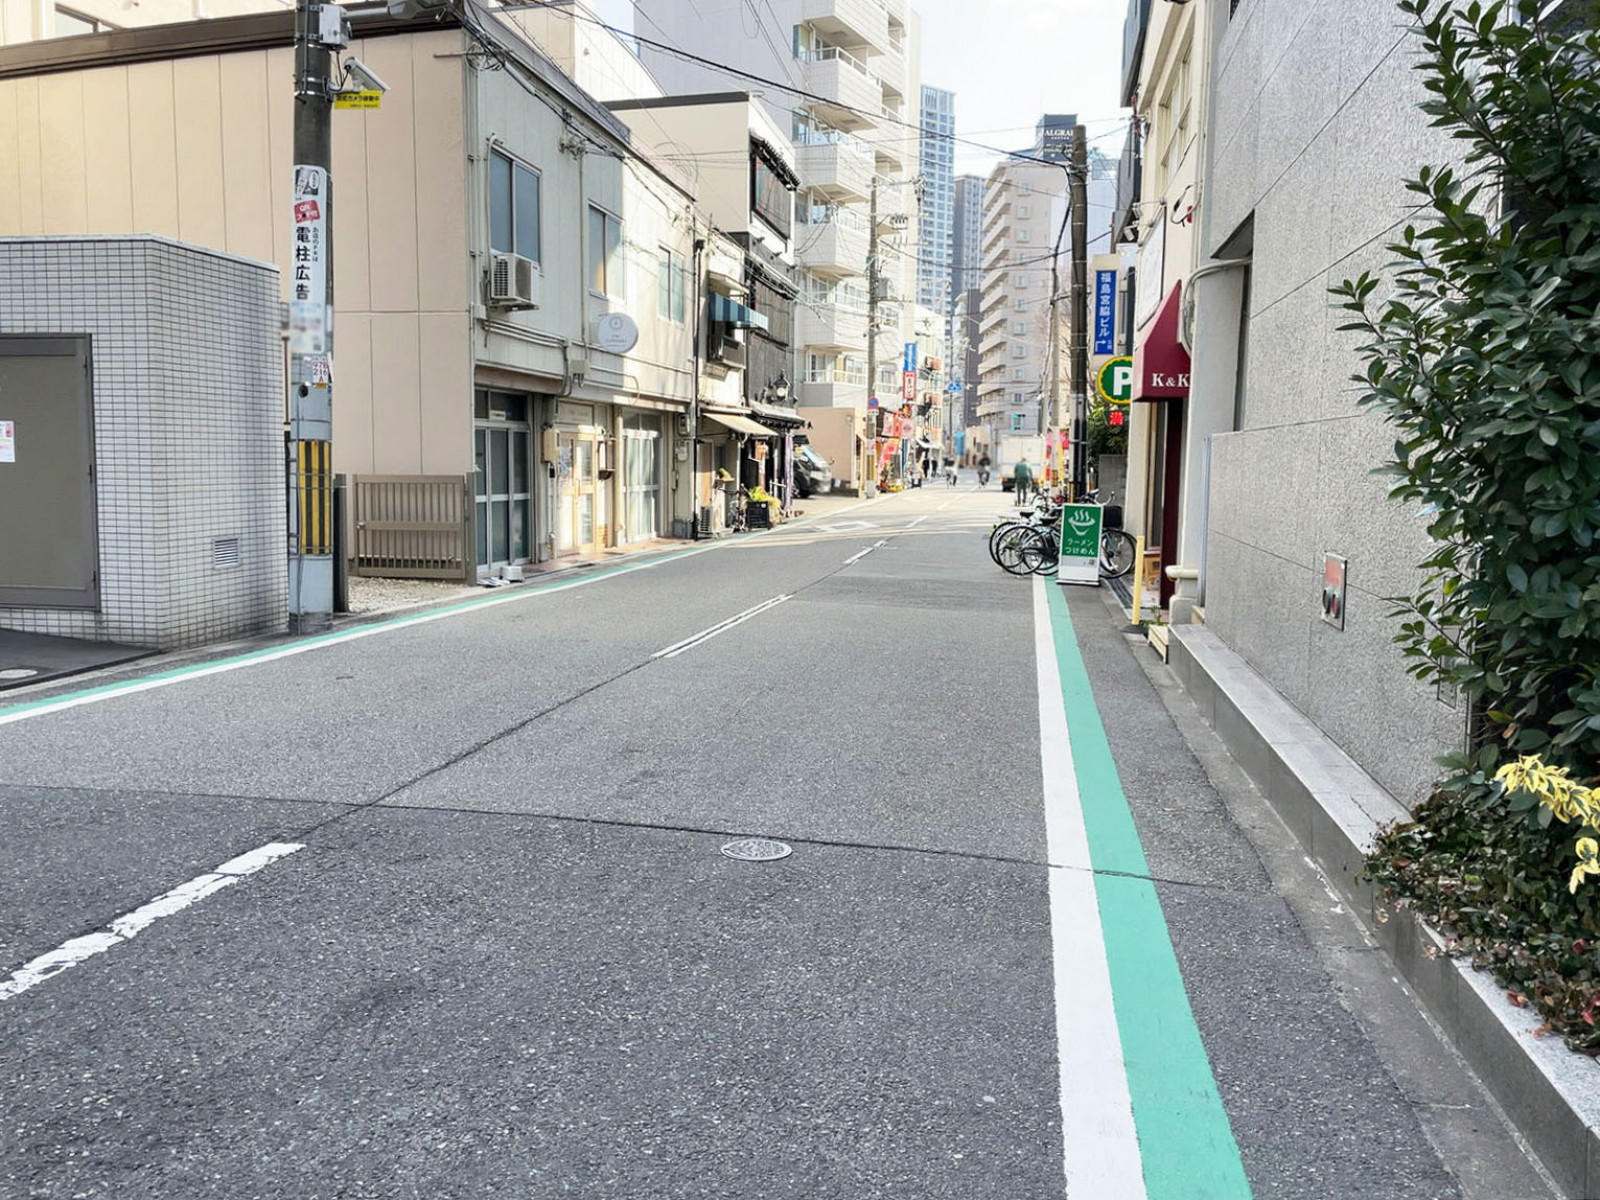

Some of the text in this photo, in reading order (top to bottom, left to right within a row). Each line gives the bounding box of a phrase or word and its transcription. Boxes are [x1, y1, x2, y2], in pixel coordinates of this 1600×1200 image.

[296, 226, 311, 300] 電柱広告
[1113, 366, 1132, 396] P
[1109, 411, 1124, 426] 満
[1065, 547, 1094, 555] つけめん
